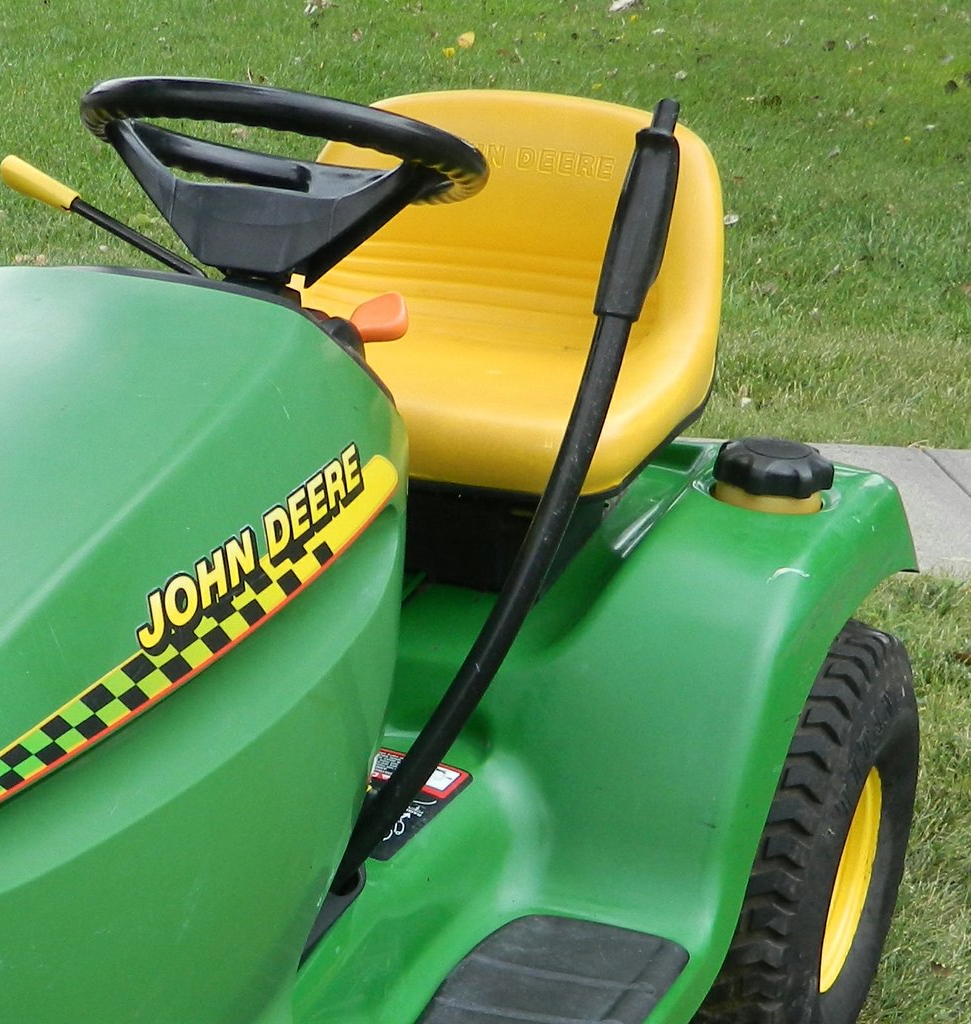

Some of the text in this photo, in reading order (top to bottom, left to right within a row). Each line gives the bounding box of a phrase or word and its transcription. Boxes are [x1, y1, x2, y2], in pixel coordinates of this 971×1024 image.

[516, 147, 616, 181] DEERE
[136, 441, 365, 656] JOHN DEERE
